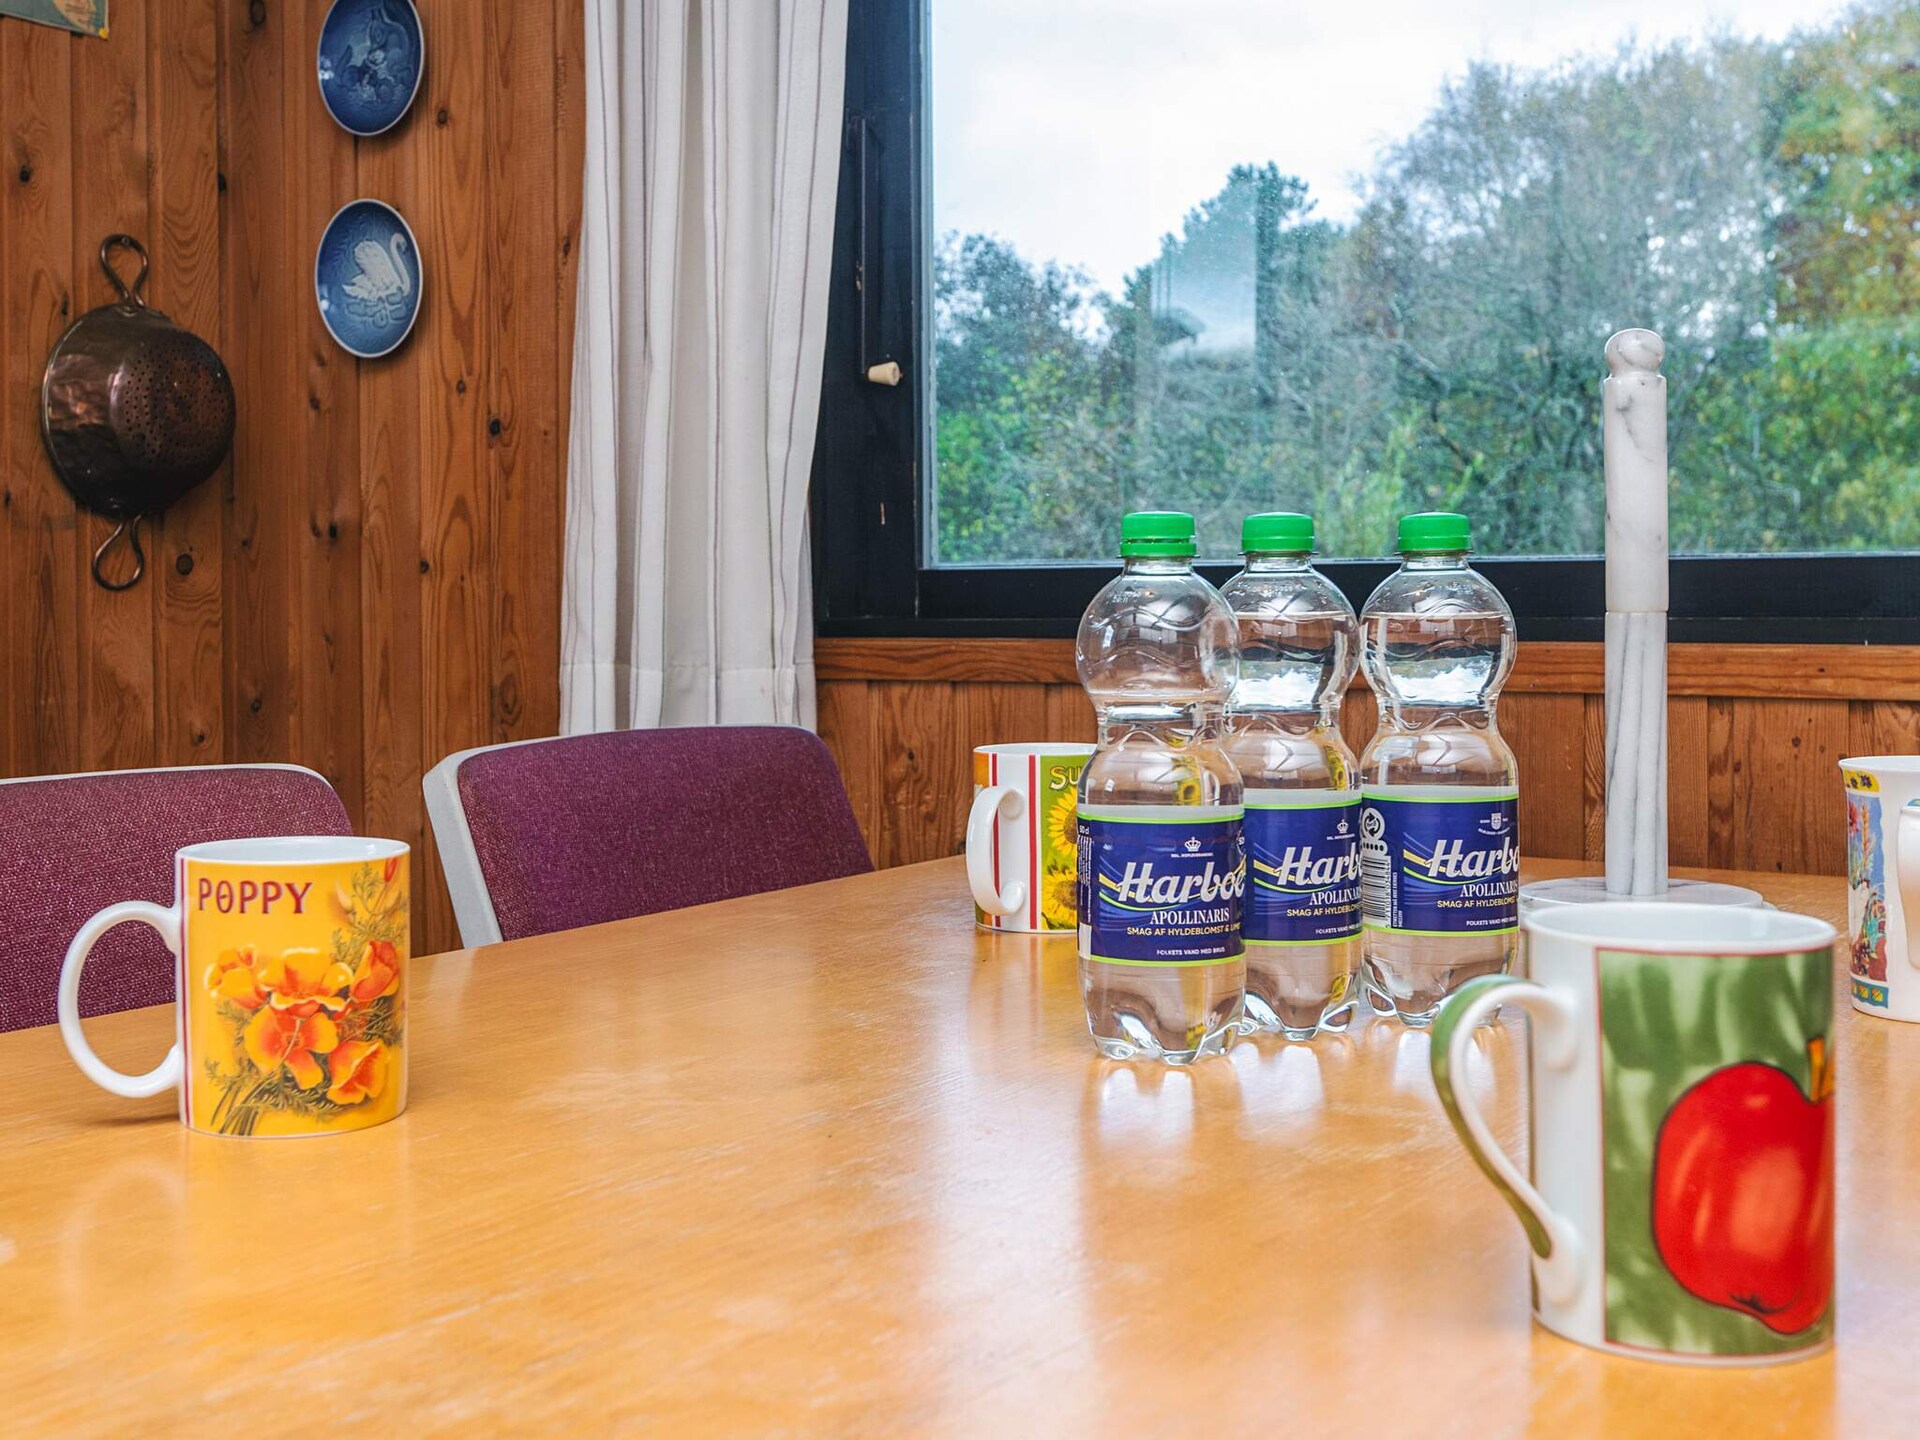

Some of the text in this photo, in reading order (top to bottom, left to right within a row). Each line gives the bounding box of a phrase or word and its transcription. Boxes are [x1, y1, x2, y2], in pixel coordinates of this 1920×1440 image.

[198, 877, 313, 914] POPPY
[1437, 901, 1461, 909] SMAG
[1464, 900, 1475, 908] AF
[1150, 907, 1230, 925] APOLLINARIS
[1286, 908, 1311, 917] SMAG
[1313, 907, 1323, 916] AF
[1127, 926, 1152, 936] SMAG
[1154, 927, 1167, 936] AF
[1168, 925, 1224, 936] HYLDEBLOMST
